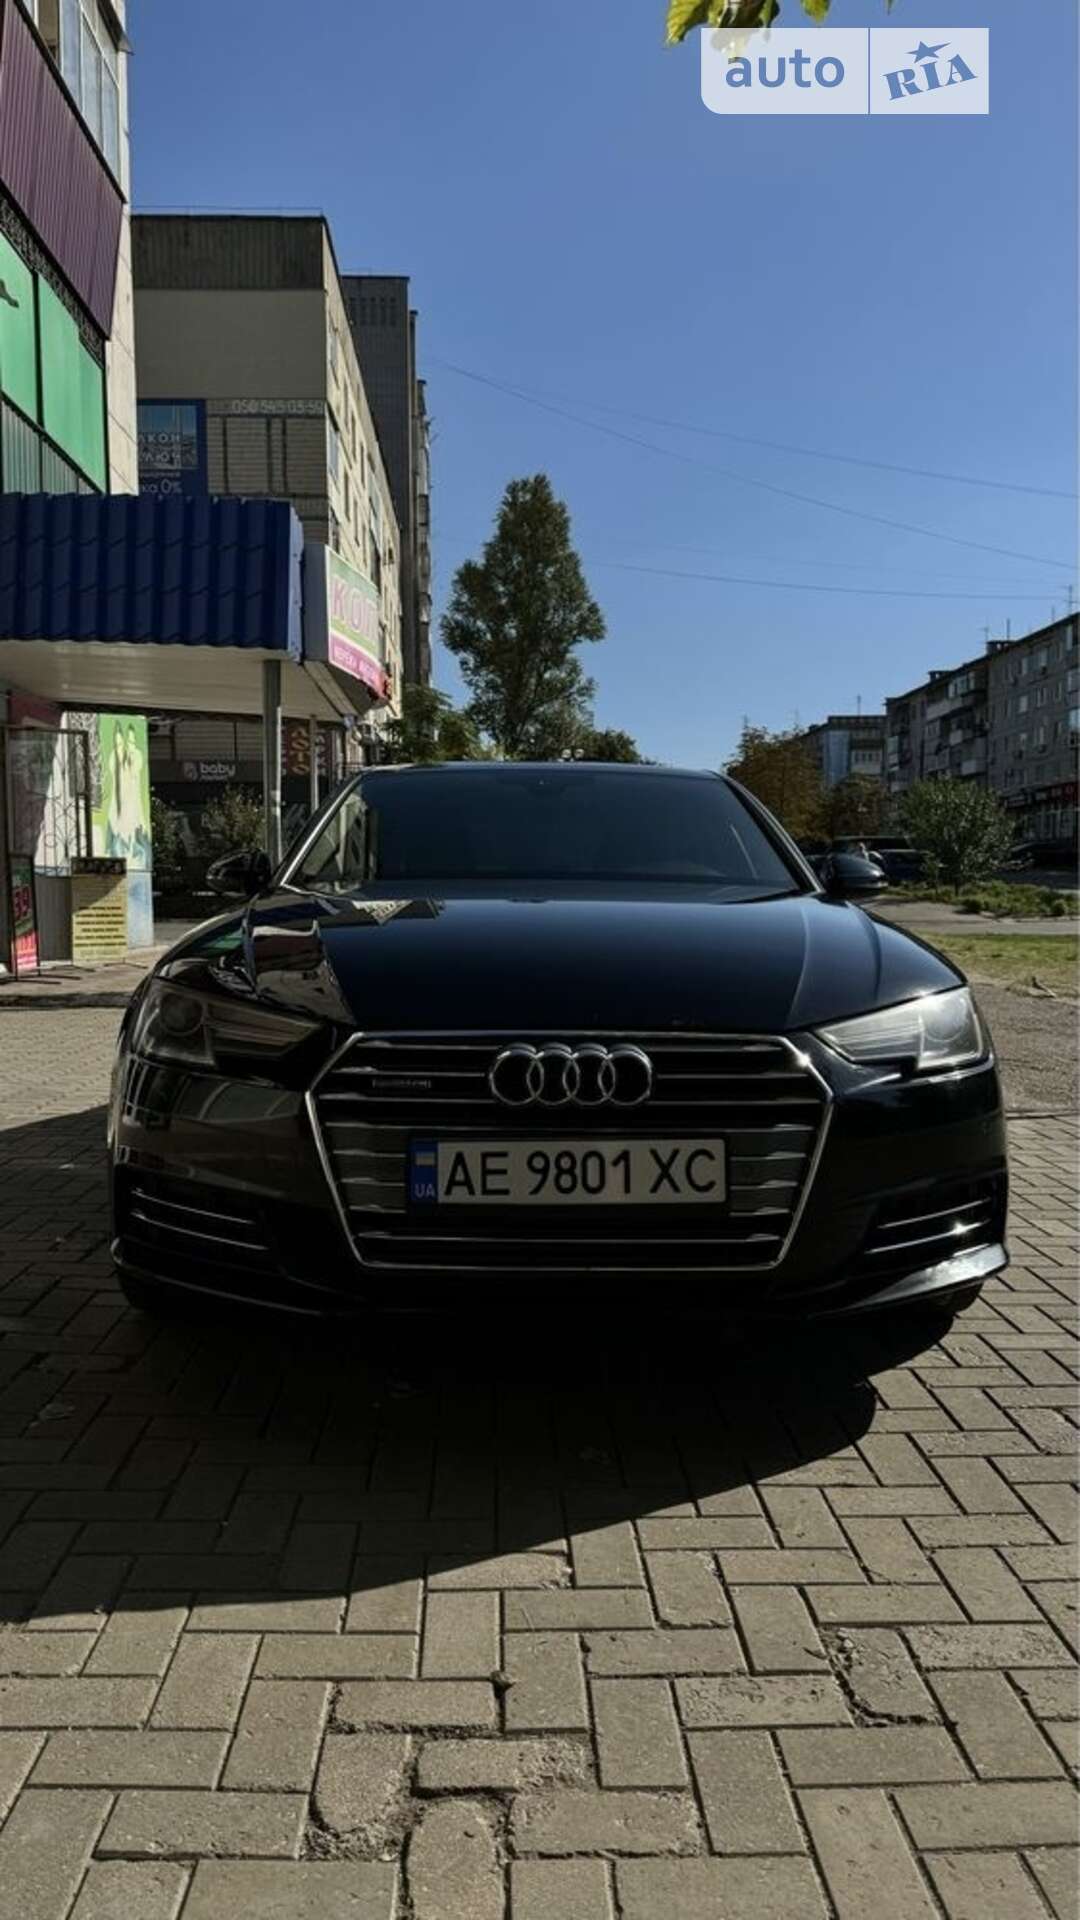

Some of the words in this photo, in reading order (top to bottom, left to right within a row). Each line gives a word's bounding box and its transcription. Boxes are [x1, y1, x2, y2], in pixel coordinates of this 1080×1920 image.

[199, 761, 236, 777] baby
[443, 1151, 510, 1197] AE
[526, 1150, 632, 1195] 9801
[649, 1148, 718, 1194] XC
[414, 1184, 436, 1198] UA
